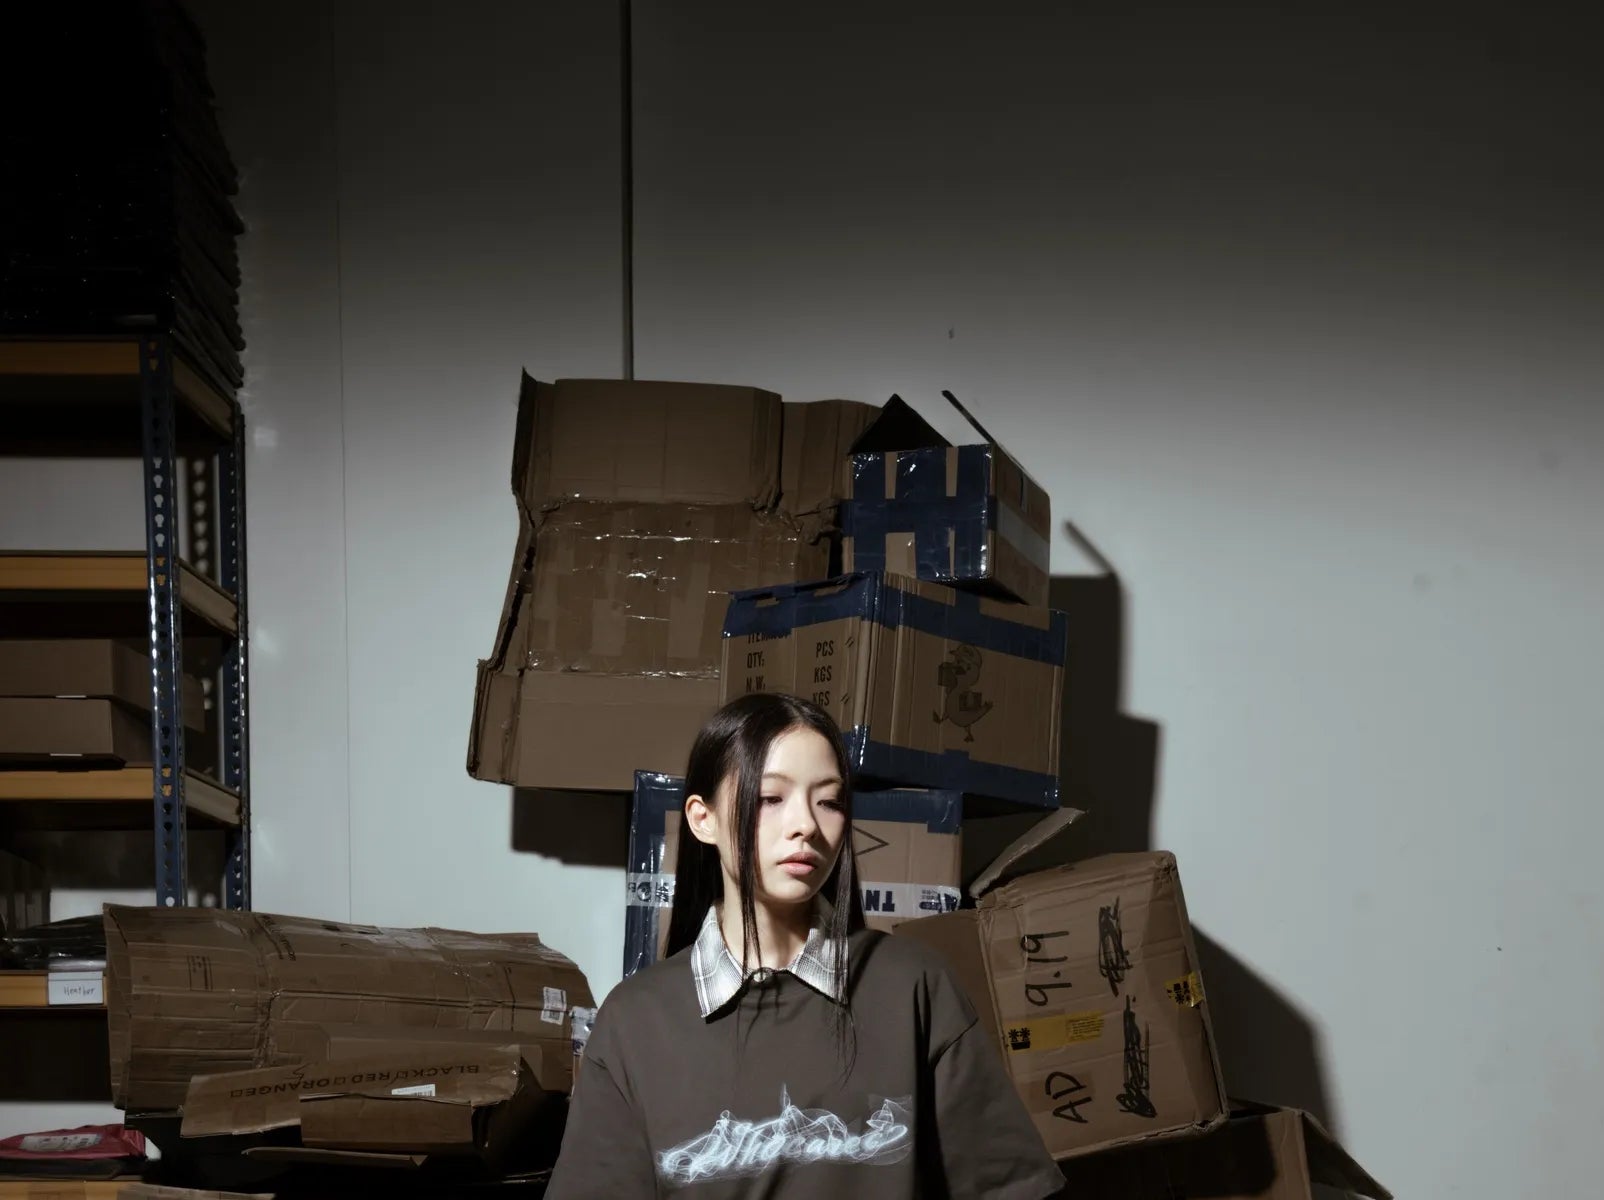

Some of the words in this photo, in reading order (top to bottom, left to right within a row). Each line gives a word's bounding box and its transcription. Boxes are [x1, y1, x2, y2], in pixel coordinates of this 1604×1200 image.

[816, 640, 834, 658] PCS
[814, 665, 832, 683] KGS
[1020, 931, 1072, 1006] 9.19
[351, 1071, 391, 1084] RED
[413, 1064, 479, 1078] BLACK
[245, 1078, 330, 1097] ORANGE
[1045, 1071, 1092, 1124] AD
